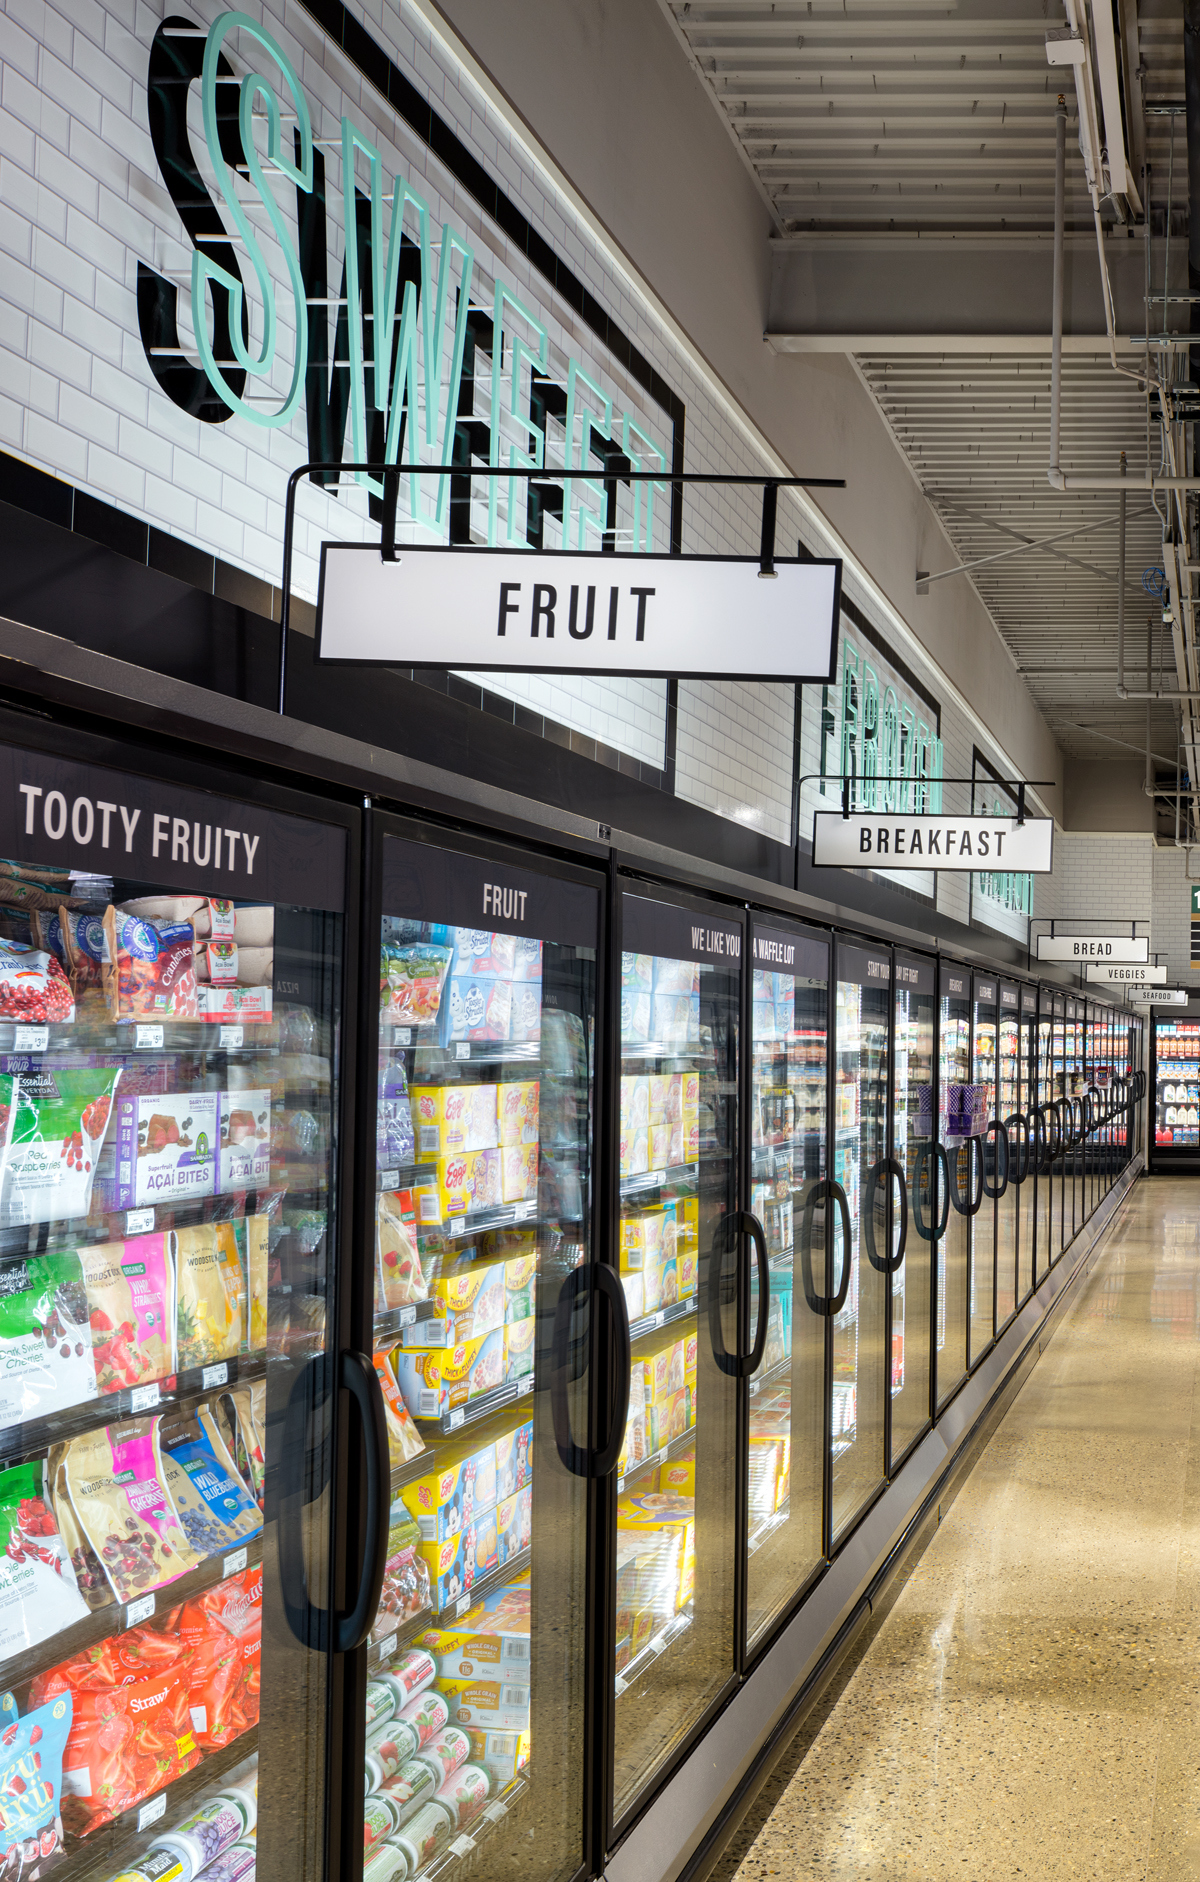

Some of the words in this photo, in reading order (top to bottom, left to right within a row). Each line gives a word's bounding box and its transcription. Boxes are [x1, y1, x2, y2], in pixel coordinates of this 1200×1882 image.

[137, 11, 666, 552] SWEET
[497, 582, 656, 641] FRUIT
[19, 784, 141, 853] TOOTY
[152, 813, 260, 875] FRUITY
[860, 828, 1006, 856] BREAKFAST
[483, 883, 528, 921] FRUIT
[691, 926, 705, 951] WE
[706, 930, 724, 954] LIKE
[725, 934, 741, 957] YOU
[753, 938, 758, 958] A
[758, 939, 783, 963] WAFFLE
[783, 945, 795, 965] LOT
[1074, 943, 1112, 955] BREAD
[868, 961, 880, 978] START
[1108, 969, 1146, 979] VEGGIES
[1143, 991, 1171, 1000] SEAFOOD
[18, 1073, 54, 1087] Essential
[445, 1094, 465, 1120] Eggo
[504, 1090, 522, 1115] Eggo
[147, 1169, 175, 1190] AÇAÍ
[178, 1167, 209, 1185] BITES
[148, 1164, 173, 1172] Superfruit
[445, 1161, 467, 1188] Eggo
[123, 1264, 144, 1274] ORGANIC
[682, 1258, 693, 1282] Eggo
[449, 1296, 463, 1308] THICK
[466, 1280, 480, 1304] FLUFFY
[457, 1276, 470, 1294] Eggo
[444, 1366, 459, 1377] THICK
[461, 1349, 477, 1373] FLUFFY
[453, 1346, 466, 1364] Eggo
[655, 1356, 668, 1382] Eggo
[193, 1472, 219, 1491] WILD
[441, 1474, 454, 1497] Eggo
[668, 1470, 689, 1482] Eggo
[418, 1485, 433, 1509] Eggo
[440, 1544, 454, 1568] Eggo
[422, 1632, 442, 1646] Eggo
[433, 1638, 460, 1655] FLUFFY
[465, 1642, 480, 1650] WHOLE
[480, 1643, 499, 1652] GRAIN
[464, 1690, 479, 1698] WHOLE
[479, 1690, 497, 1699] GRAIN
[215, 1810, 233, 1826] 100%
[218, 1817, 237, 1837] JUICE
[138, 1850, 169, 1872] Minute
[150, 1858, 173, 1875] Maid
